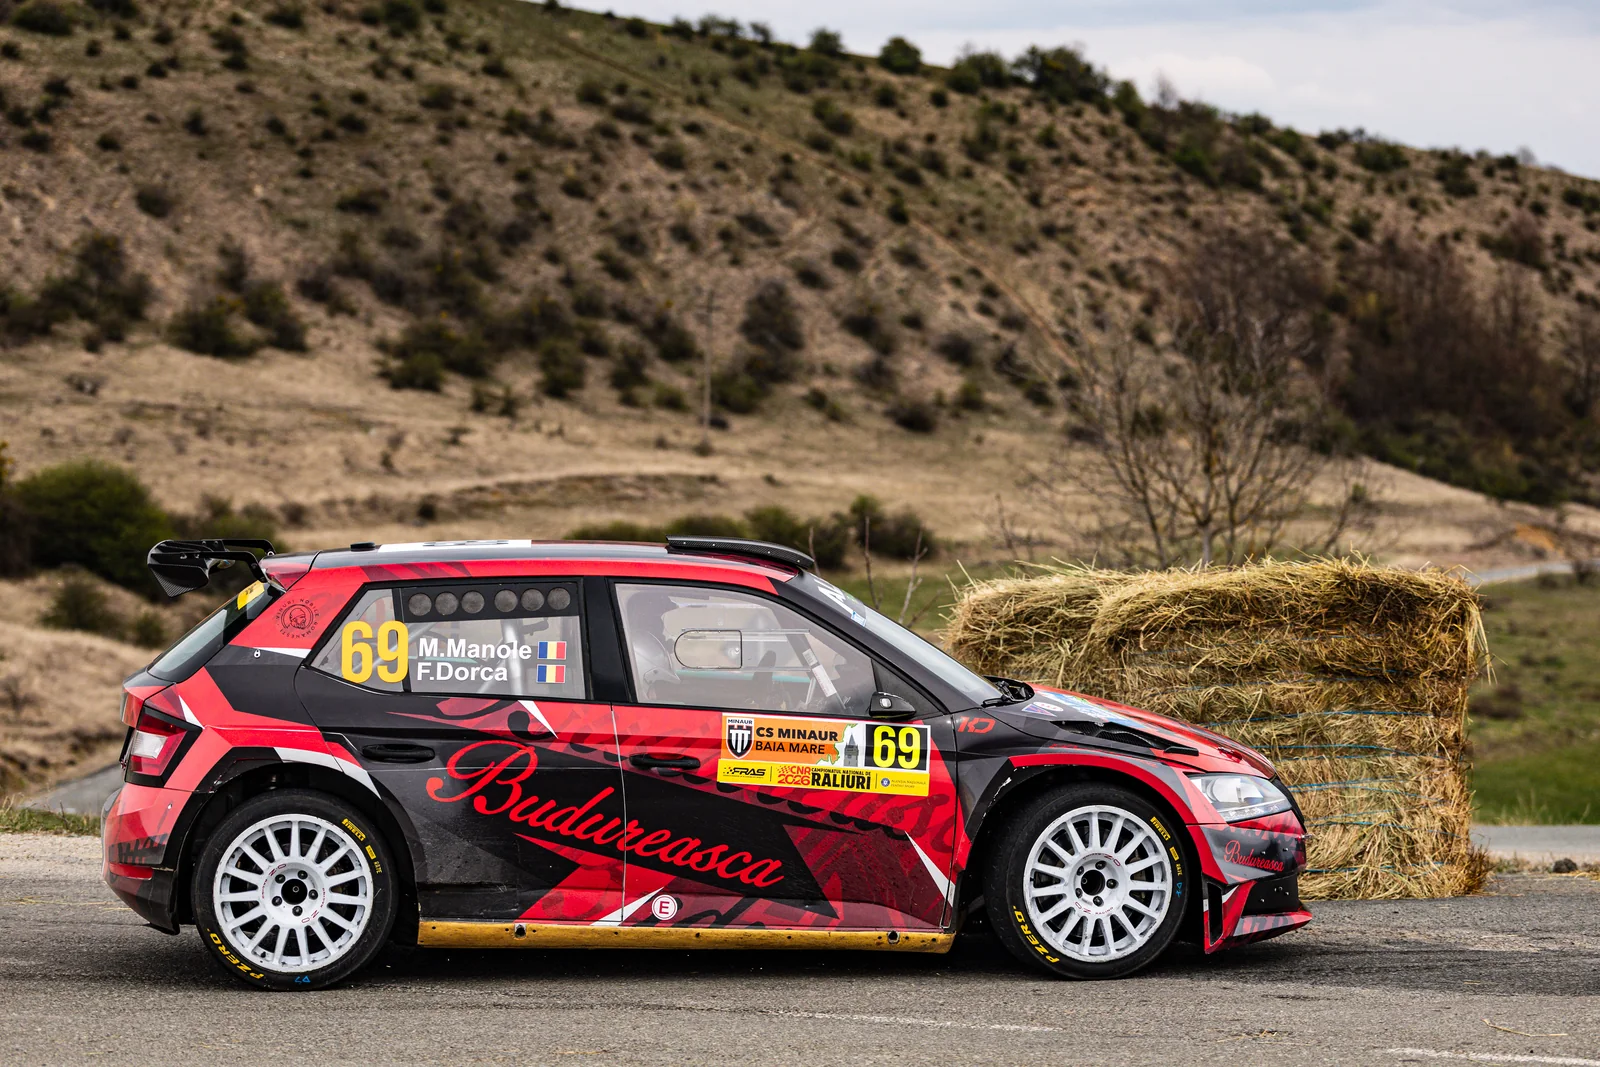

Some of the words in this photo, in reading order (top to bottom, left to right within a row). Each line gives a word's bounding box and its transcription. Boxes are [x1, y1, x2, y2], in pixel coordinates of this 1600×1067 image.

[341, 620, 409, 684] 69
[418, 637, 533, 660] M.Manole
[416, 661, 508, 682] F.Dorca
[727, 718, 753, 726] MINAUR
[755, 726, 775, 739] CS
[777, 728, 839, 742] MINAUR
[755, 741, 783, 752] BAIA
[787, 743, 826, 755] MARE
[872, 725, 921, 769] 69
[731, 767, 767, 776] FRAS
[777, 773, 811, 786] 2026
[790, 765, 811, 775] CNR
[811, 772, 871, 790] RALIURI
[425, 740, 785, 889] Budureasca
[341, 818, 366, 842] PIRELLI
[1150, 816, 1171, 841] PIRELLI
[1223, 840, 1285, 872] Budureasca
[658, 900, 671, 914] E
